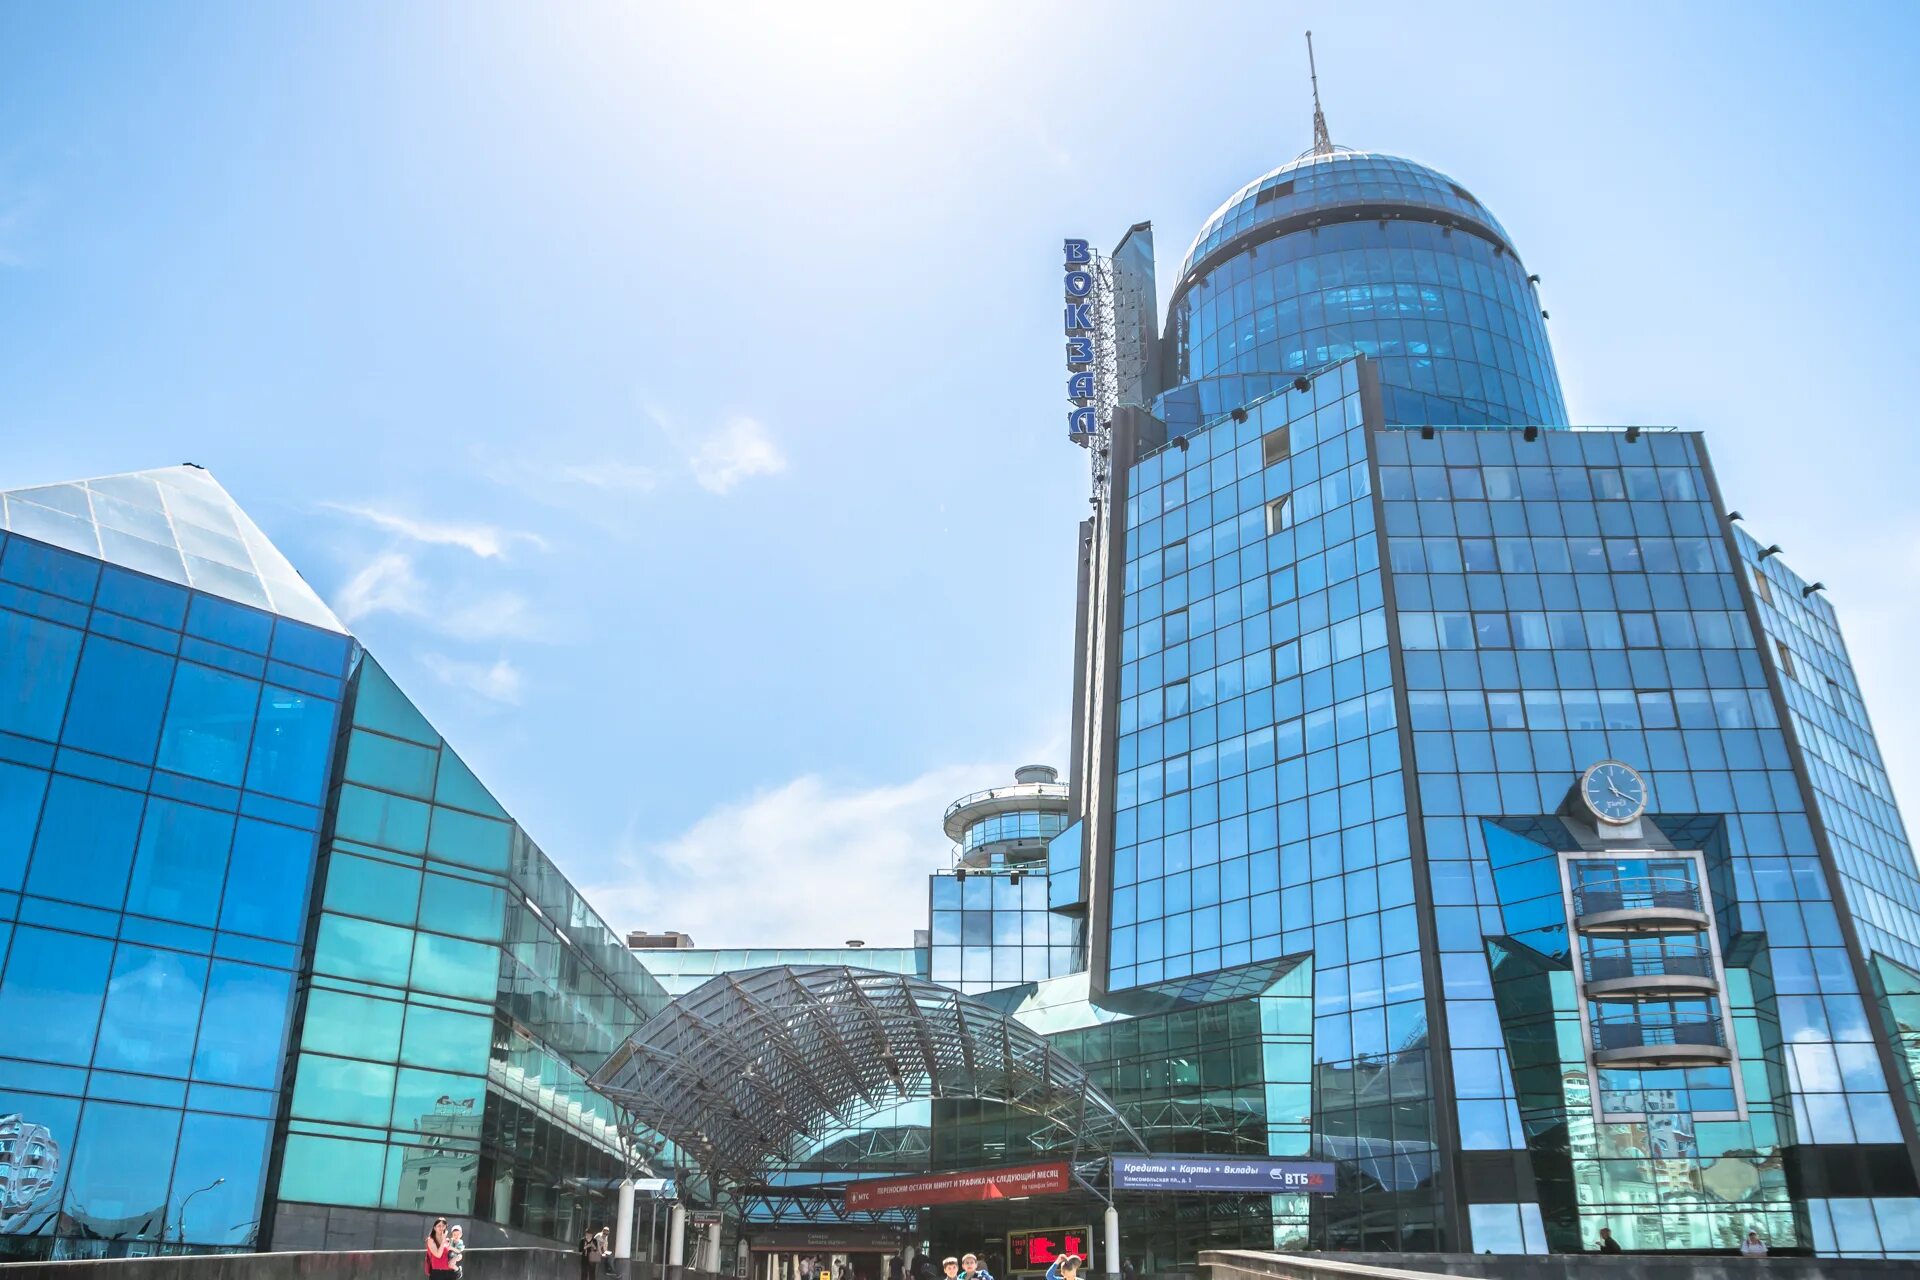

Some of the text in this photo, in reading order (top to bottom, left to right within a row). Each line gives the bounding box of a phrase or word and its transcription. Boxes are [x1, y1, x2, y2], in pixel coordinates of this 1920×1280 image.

[1064, 238, 1096, 434] ВОКЗАЛ
[1124, 1163, 1258, 1175] Кредиты Карты Вклады
[877, 1169, 1059, 1195] ПЕРЕНОСИМ ОСТАТКИ МИНУТ И ТРАФИКА НА СЛЕДУЮЩИЙ МЕСЯЦ
[1285, 1173, 1324, 1185] ВТБ24
